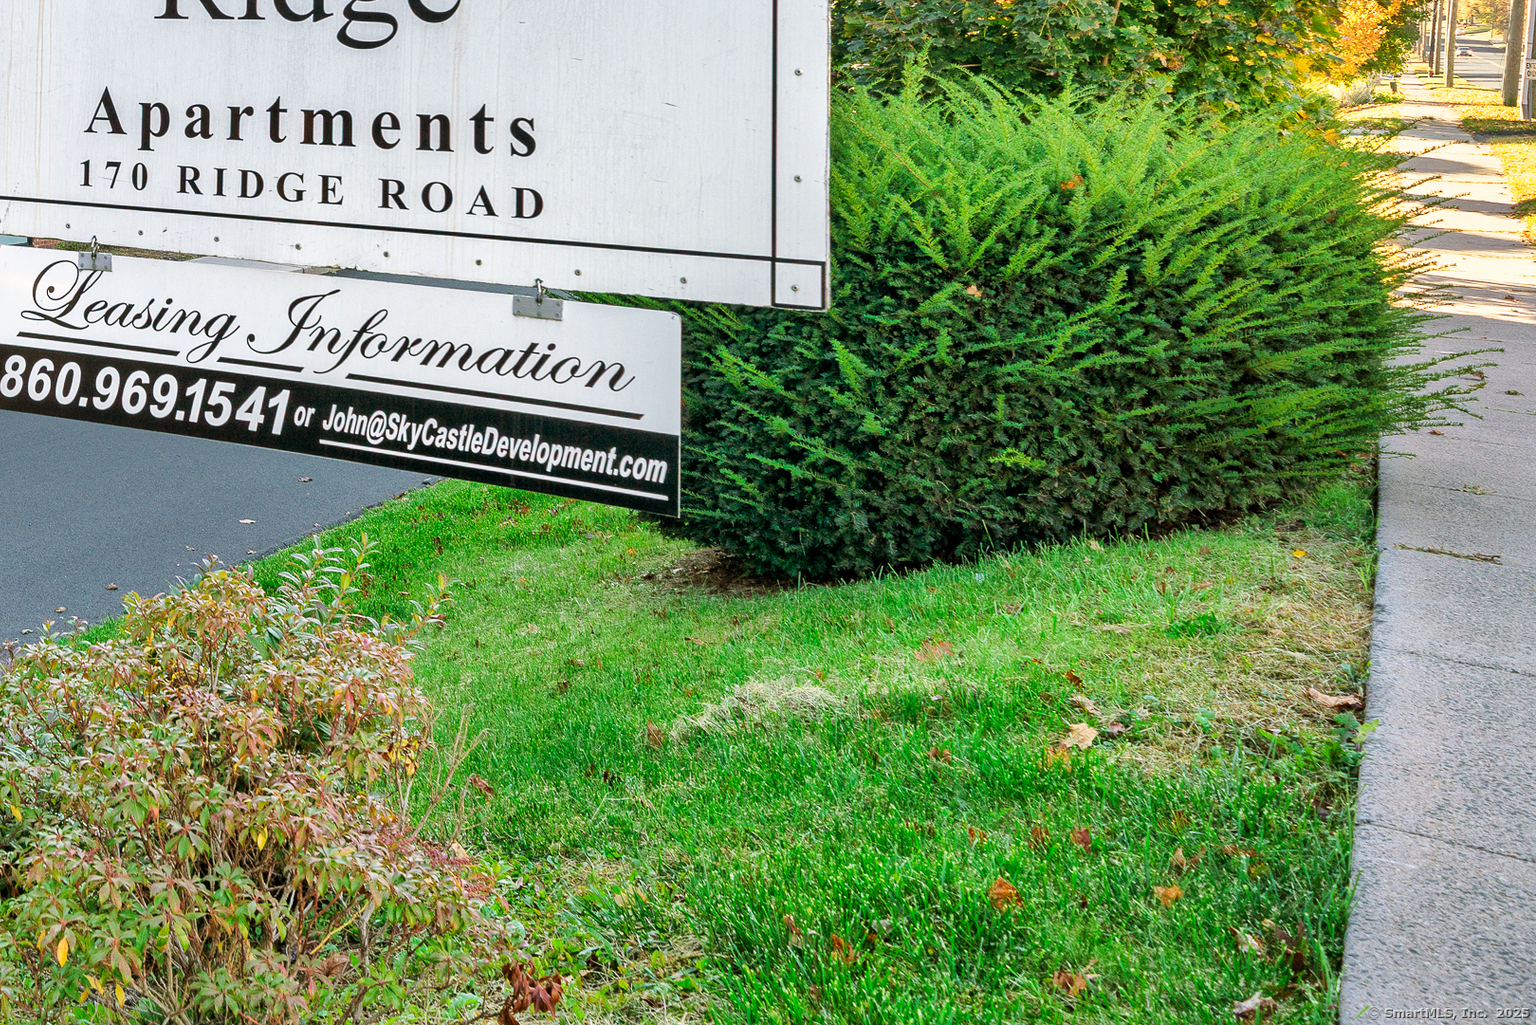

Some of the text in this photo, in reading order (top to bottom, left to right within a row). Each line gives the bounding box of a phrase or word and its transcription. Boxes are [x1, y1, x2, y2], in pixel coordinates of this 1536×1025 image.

[84, 87, 536, 158] Apartments
[80, 159, 544, 219] 170 RIDGE ROAD
[20, 259, 636, 392] Leasing Information
[0, 354, 668, 484] 860.969.1541 or John@SkyCastleDevelopment.com
